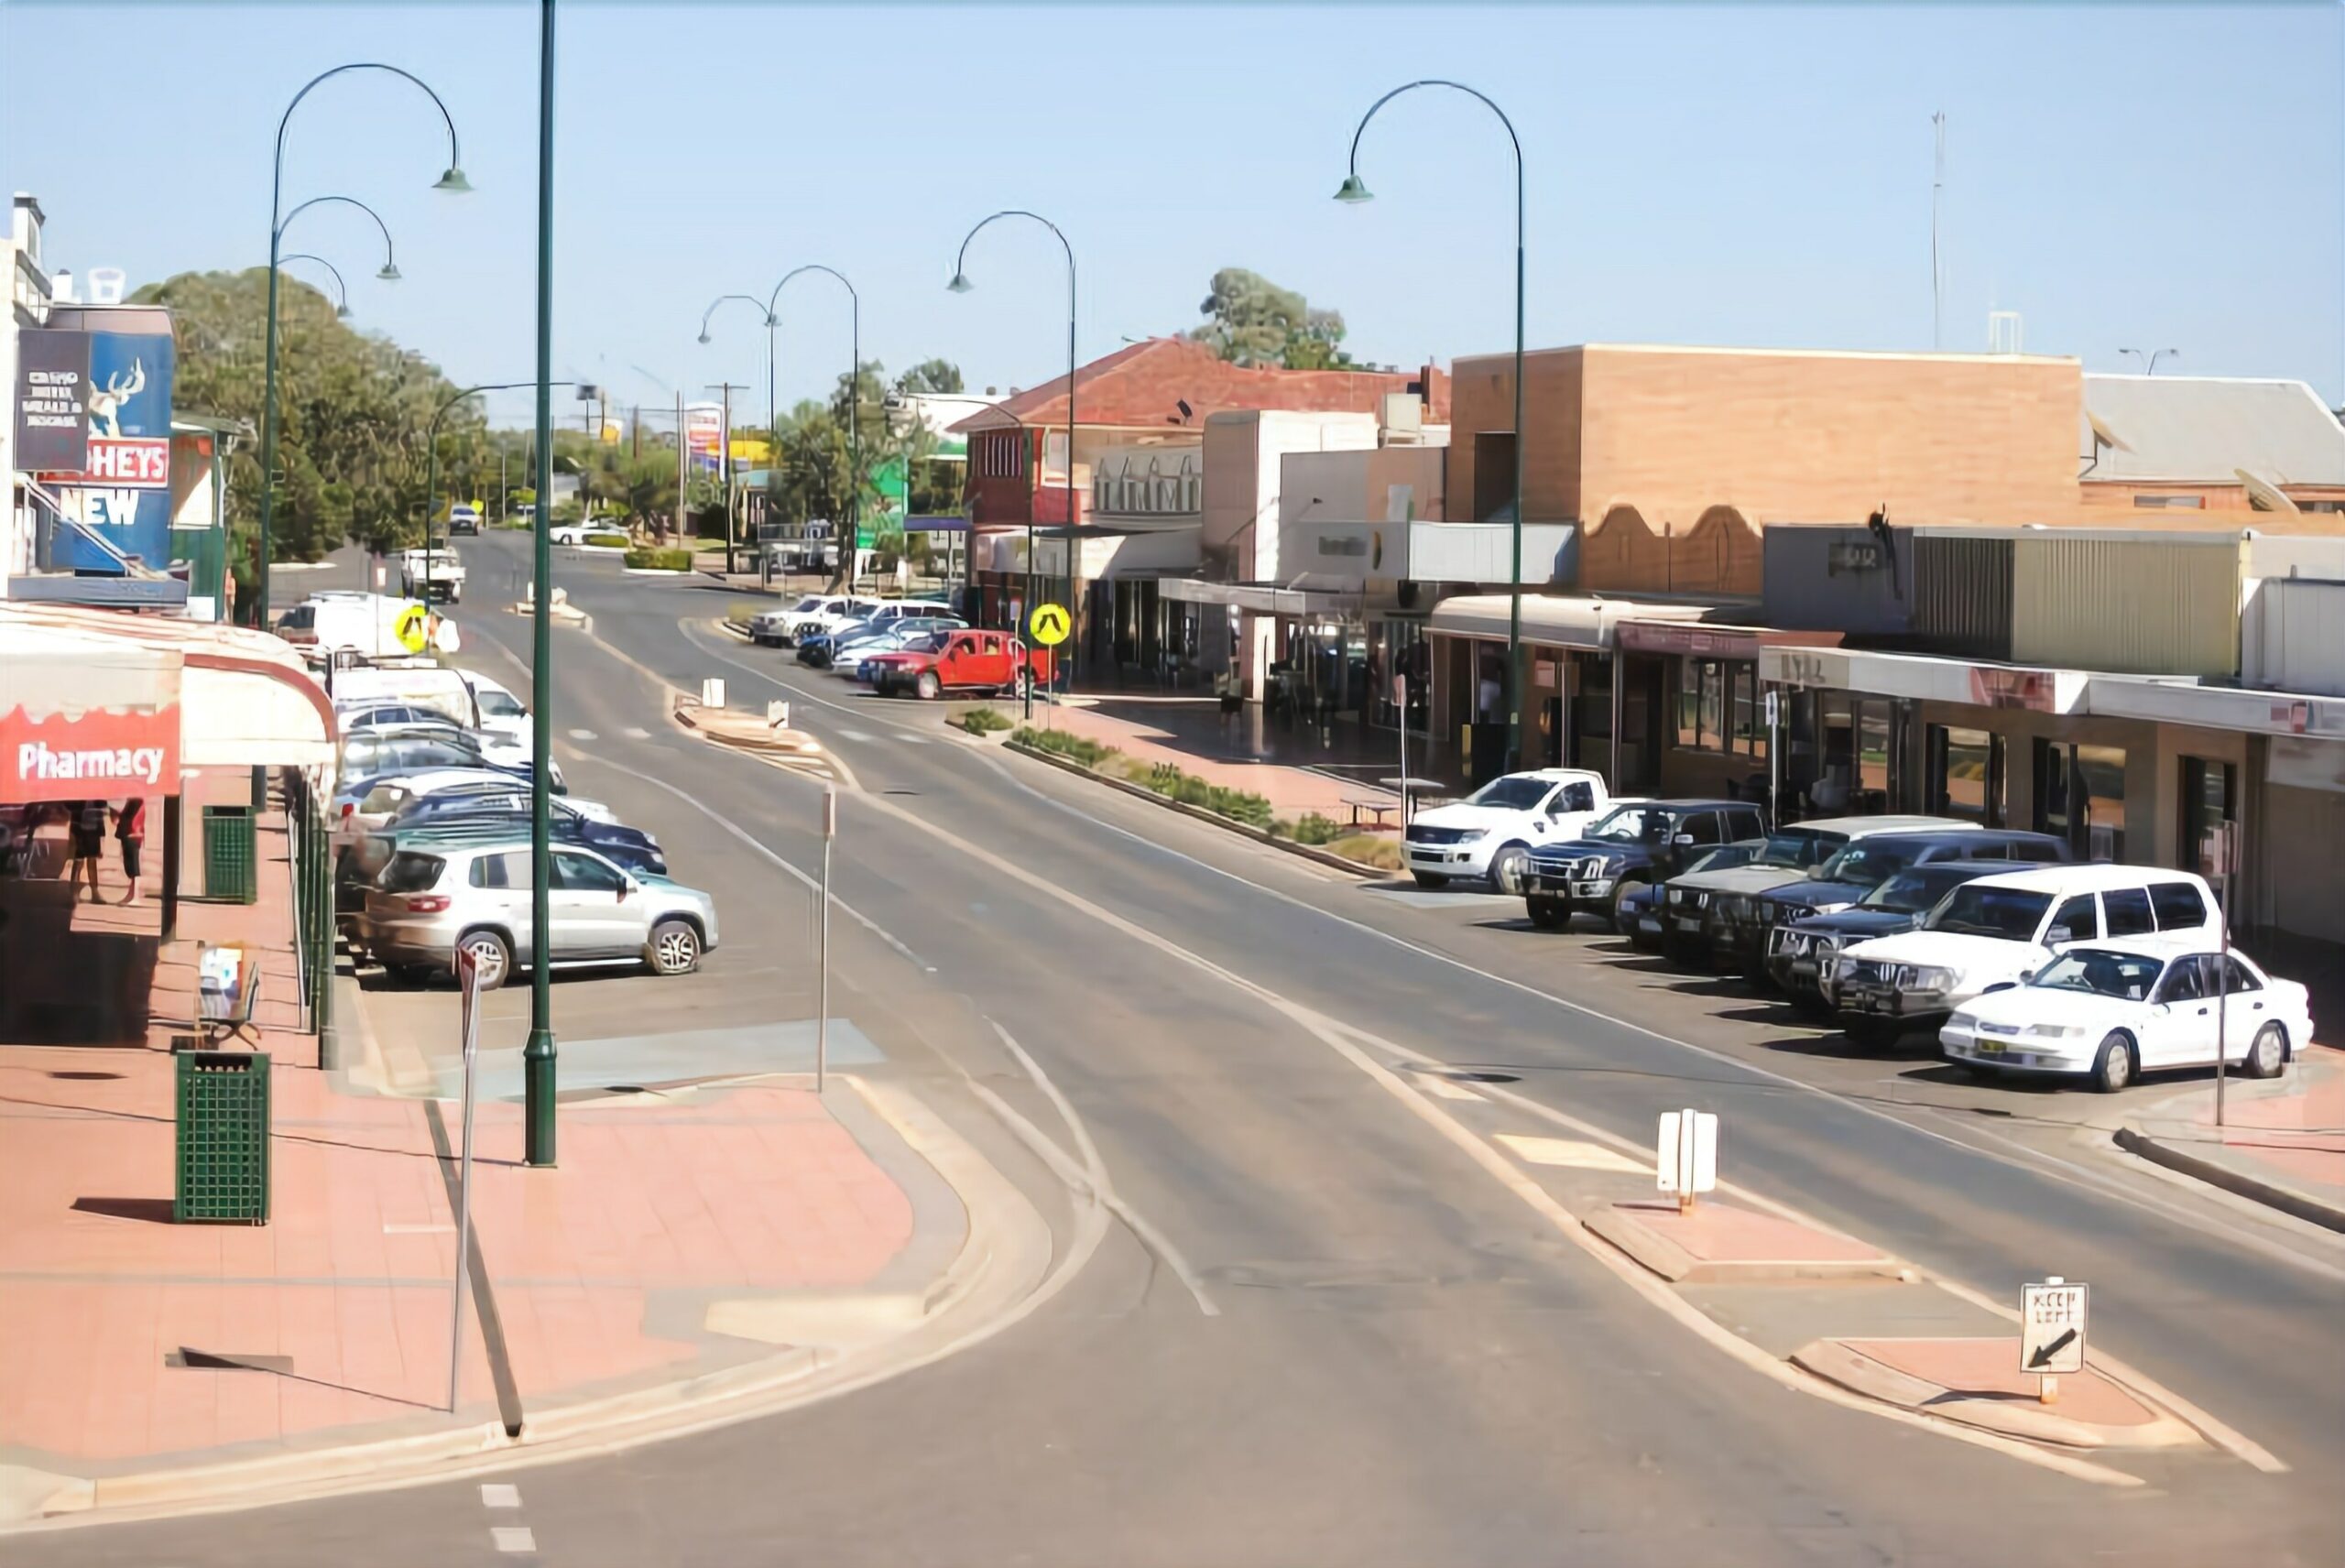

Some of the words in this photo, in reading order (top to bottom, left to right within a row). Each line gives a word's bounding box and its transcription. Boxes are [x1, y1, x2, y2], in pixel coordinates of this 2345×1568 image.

[87, 445, 164, 478] HEYS
[60, 487, 139, 525] NEW
[18, 741, 164, 784] Pharmacy
[2035, 1311, 2073, 1323] LEFT
